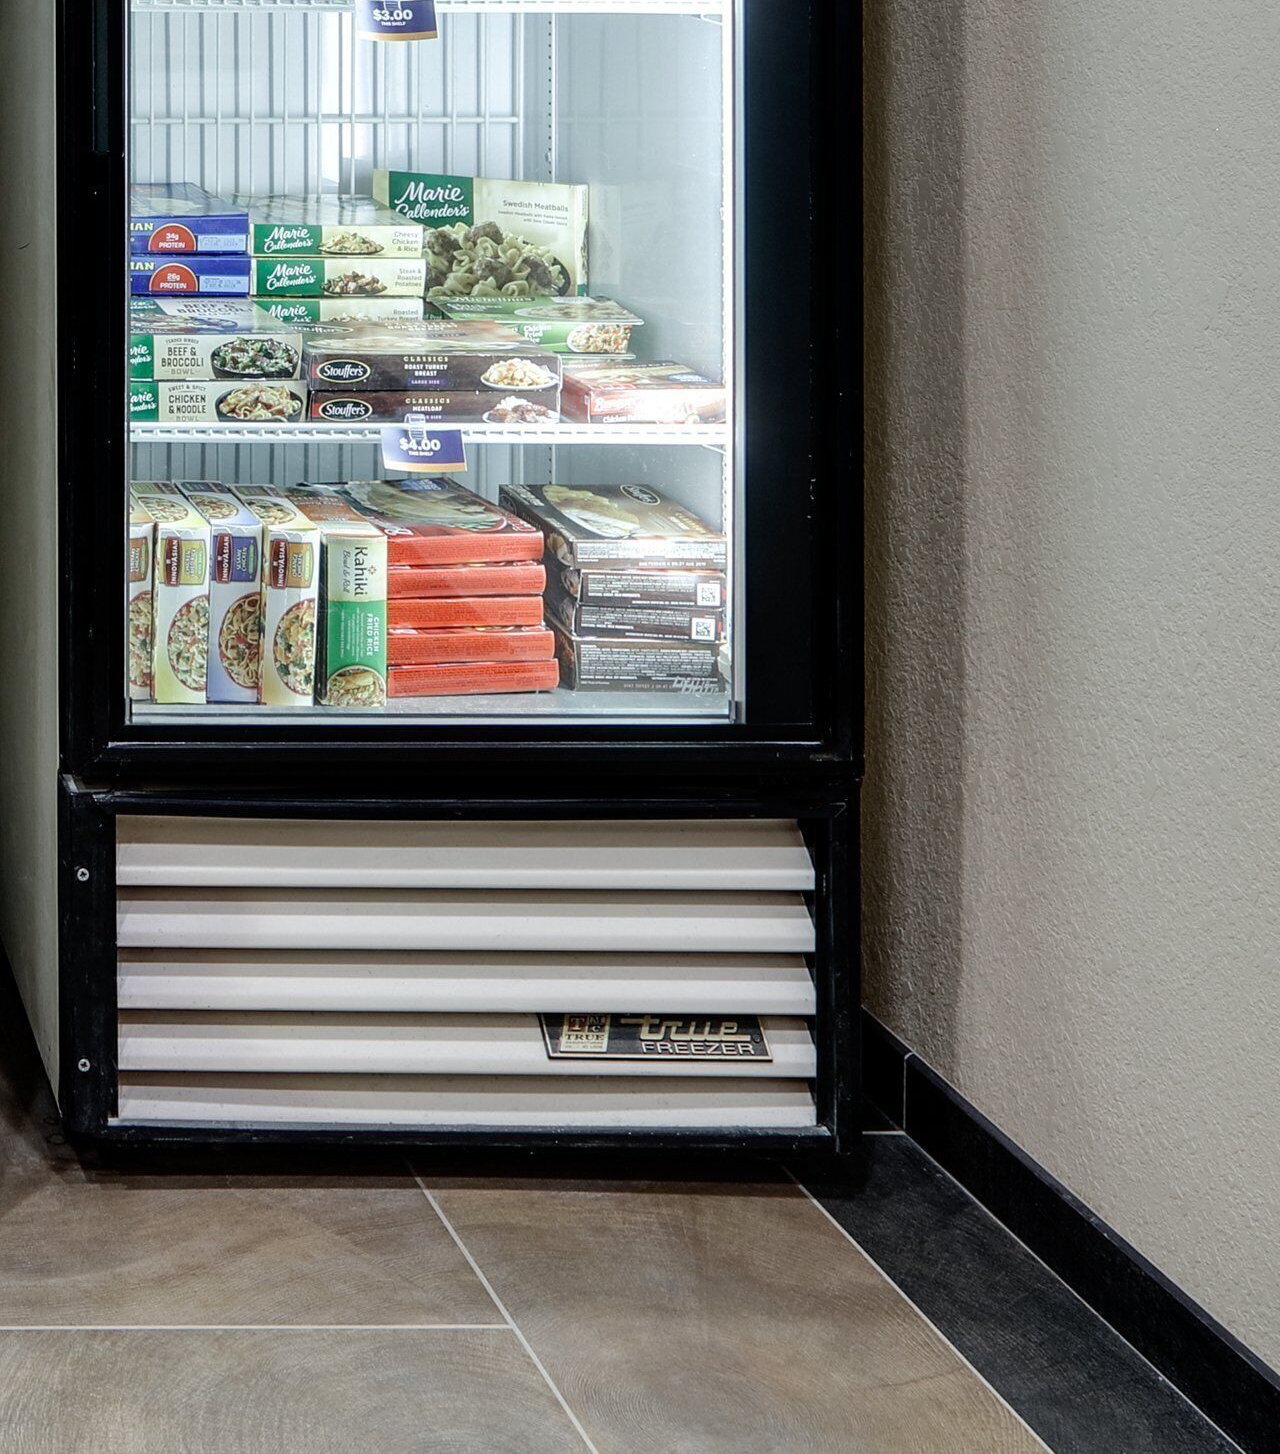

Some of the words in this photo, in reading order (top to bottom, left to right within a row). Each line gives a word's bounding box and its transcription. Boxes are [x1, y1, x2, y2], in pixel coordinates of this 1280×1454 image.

[372, 9, 413, 22] $3.00
[394, 181, 465, 204] Marie
[395, 203, 471, 220] Callender's
[503, 200, 533, 210] Swedish
[534, 202, 569, 212] Meatballs
[267, 226, 310, 241] Marie
[394, 231, 419, 240] Cheesy
[264, 238, 313, 253] Callender's
[392, 238, 419, 246] Chicken
[270, 263, 312, 279] Marie
[266, 275, 316, 291] Callender's
[396, 274, 422, 282] Roasted
[159, 282, 187, 290] PROTEIN
[269, 304, 308, 320] Marie
[167, 346, 188, 356] BEEF
[161, 357, 204, 367] BROCCOLI
[403, 355, 449, 363] CLASSICS
[323, 363, 364, 379] Stouffer's
[414, 369, 437, 377] BREAST
[168, 394, 207, 404] CHICKEN
[176, 404, 207, 414] NOODLE
[325, 403, 365, 419] Stouffer's
[399, 438, 441, 452] $4.00
[354, 546, 368, 597] Kahiki
[564, 1033, 606, 1041] TRUE
[641, 1041, 755, 1056] FREEZER
